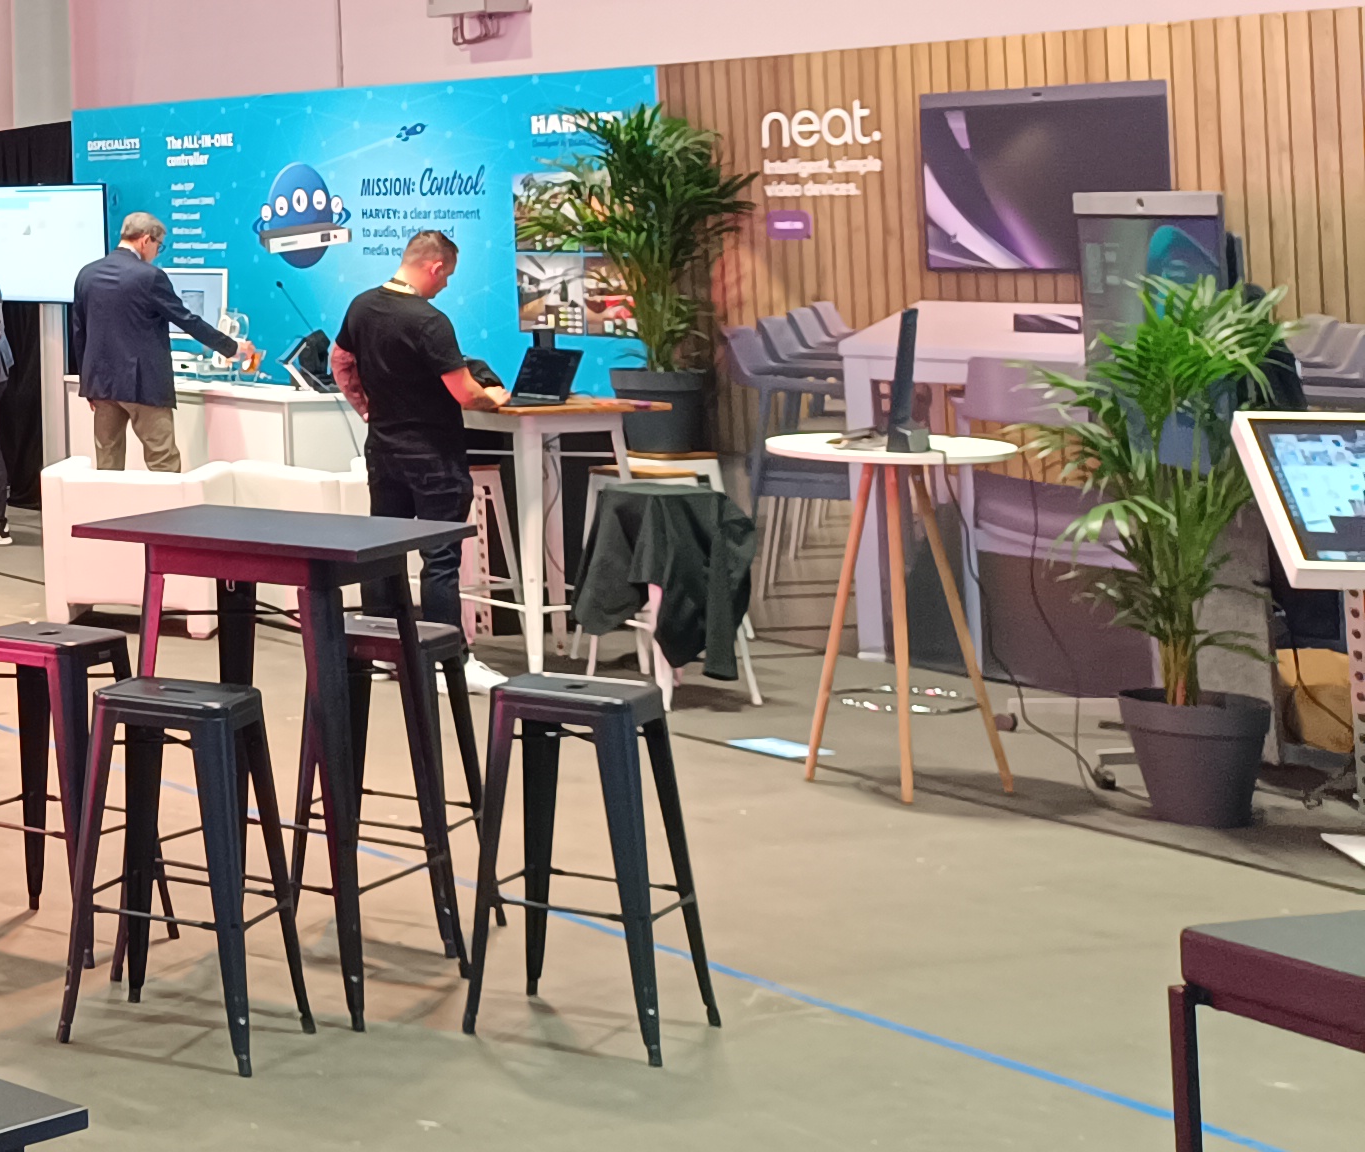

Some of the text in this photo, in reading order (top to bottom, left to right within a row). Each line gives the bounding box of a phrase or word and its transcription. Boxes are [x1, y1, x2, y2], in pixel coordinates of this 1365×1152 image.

[761, 98, 882, 149] neat.
[166, 133, 234, 150] The ALL-IN-ONE
[360, 164, 486, 196] MISSION: Control.
[361, 207, 481, 221] HARVEY: a clear statement
[362, 227, 371, 238] to
[373, 225, 400, 239] audio,
[362, 243, 390, 256] media
